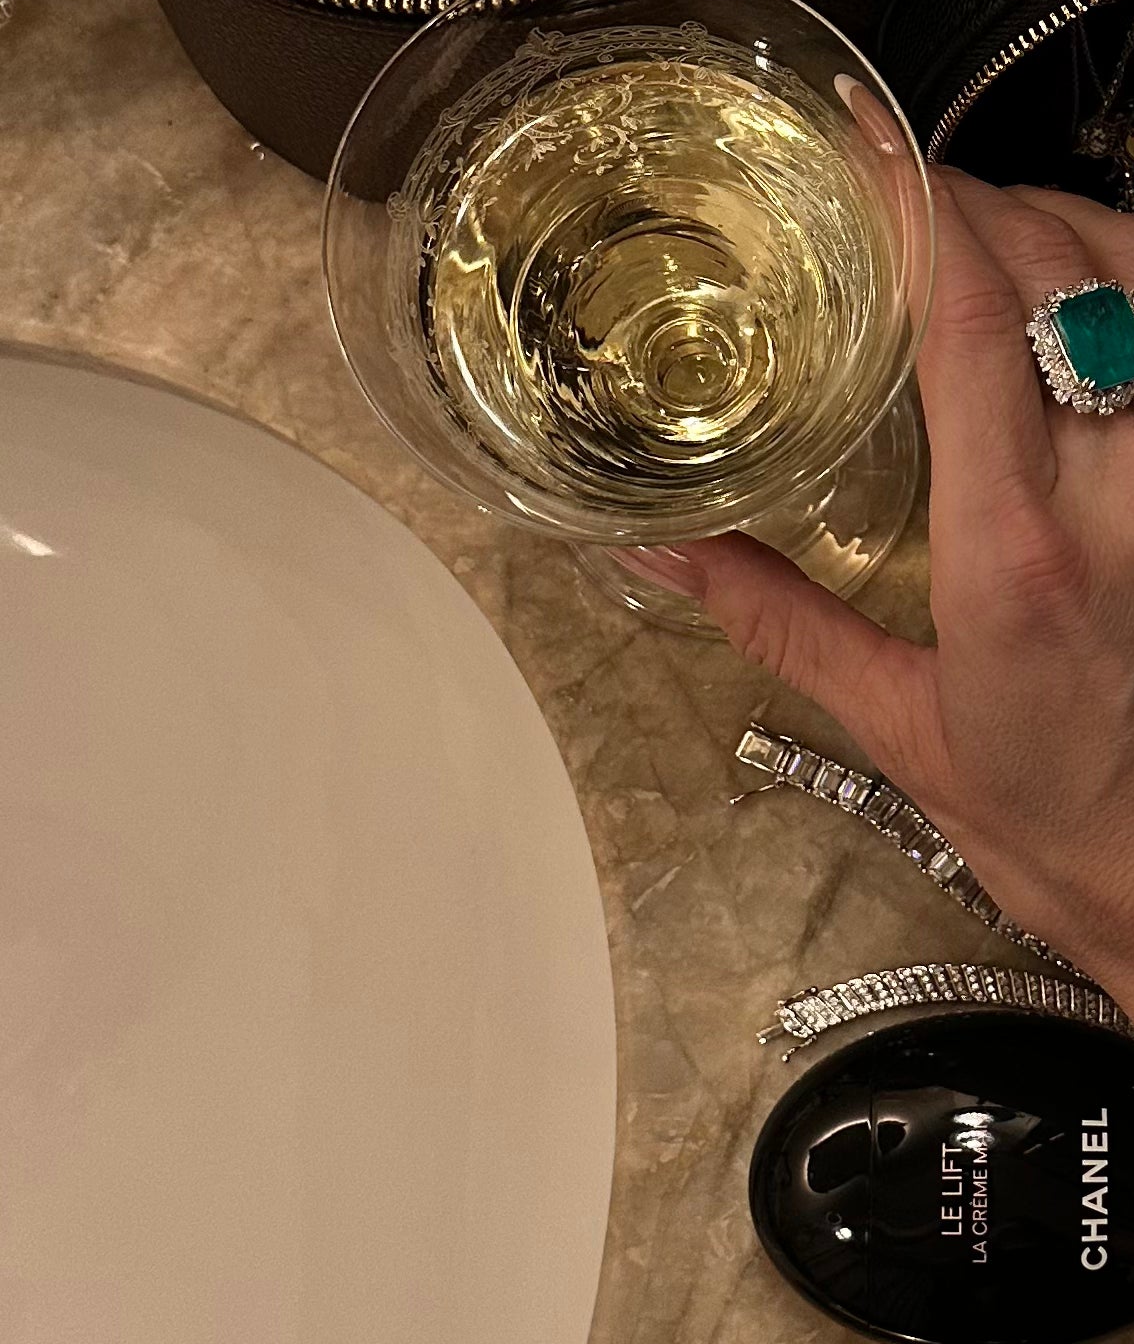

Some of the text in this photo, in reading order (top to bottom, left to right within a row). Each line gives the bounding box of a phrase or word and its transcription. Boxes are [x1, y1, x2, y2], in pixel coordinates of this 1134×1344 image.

[941, 1142, 963, 1236] LE LIFT
[968, 1169, 988, 1236] CRÈME
[1080, 1107, 1109, 1272] CHANEL
[972, 1240, 988, 1264] LA
